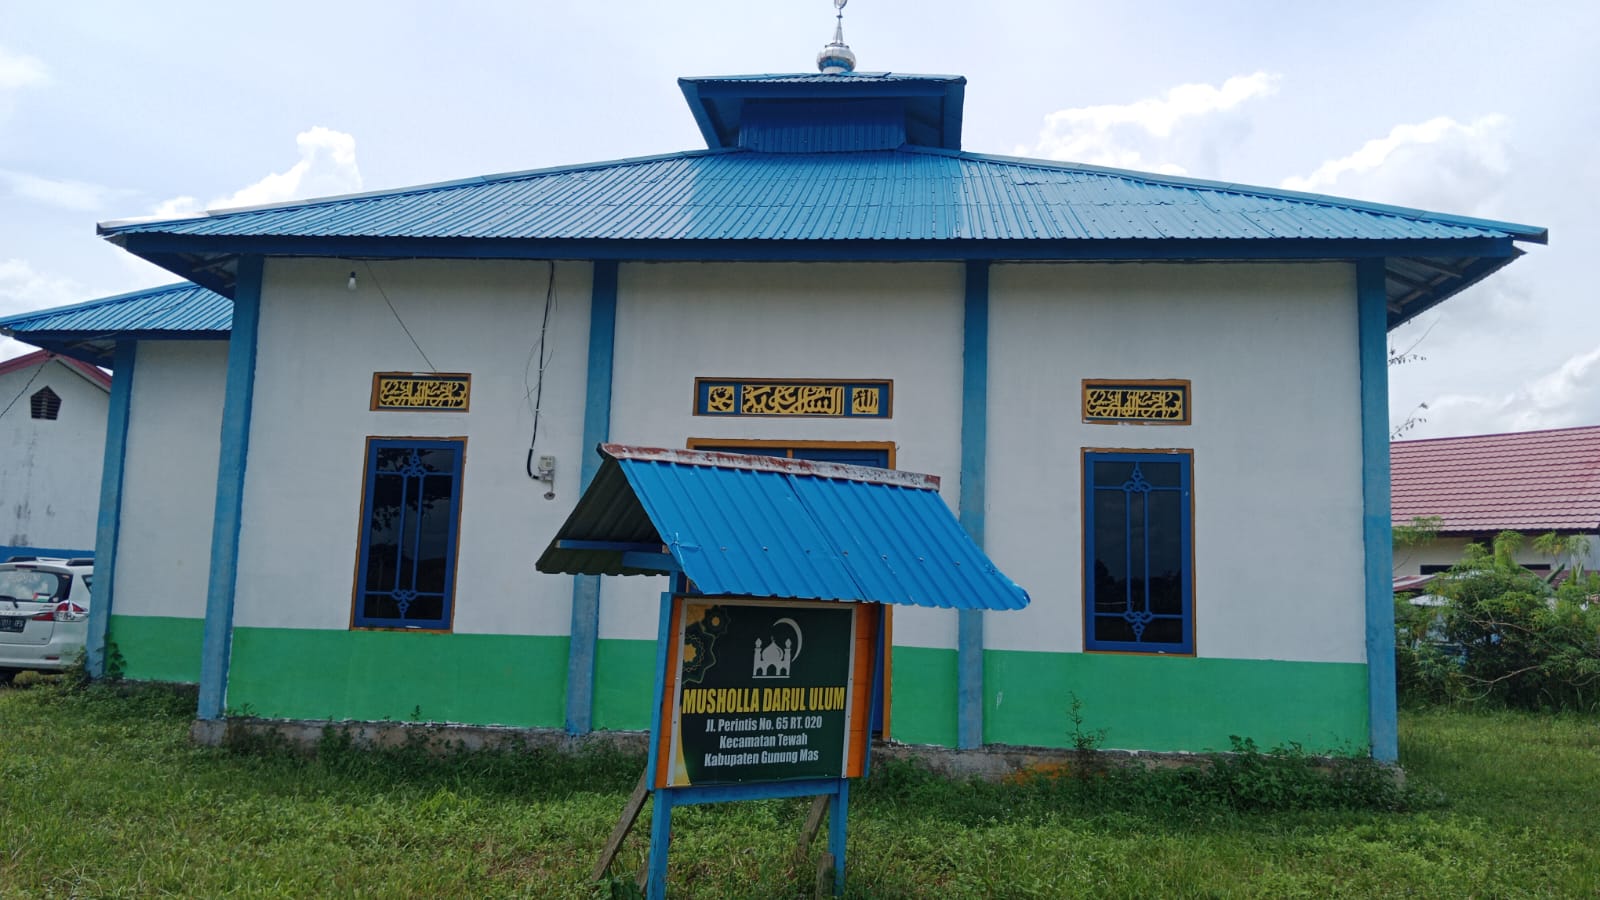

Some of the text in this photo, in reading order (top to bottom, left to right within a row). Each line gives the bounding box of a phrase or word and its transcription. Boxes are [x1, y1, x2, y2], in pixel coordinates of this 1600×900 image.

[682, 687, 845, 714] MUSHOLLA DARUL ULUM
[718, 717, 758, 732] Perintis
[759, 717, 774, 730] No.
[775, 716, 789, 730] 65
[790, 716, 803, 729] RT.
[804, 715, 823, 729] 020
[719, 733, 808, 749] Kecamatan Tewah
[704, 748, 819, 767] Kabupaten Gunung Mas
